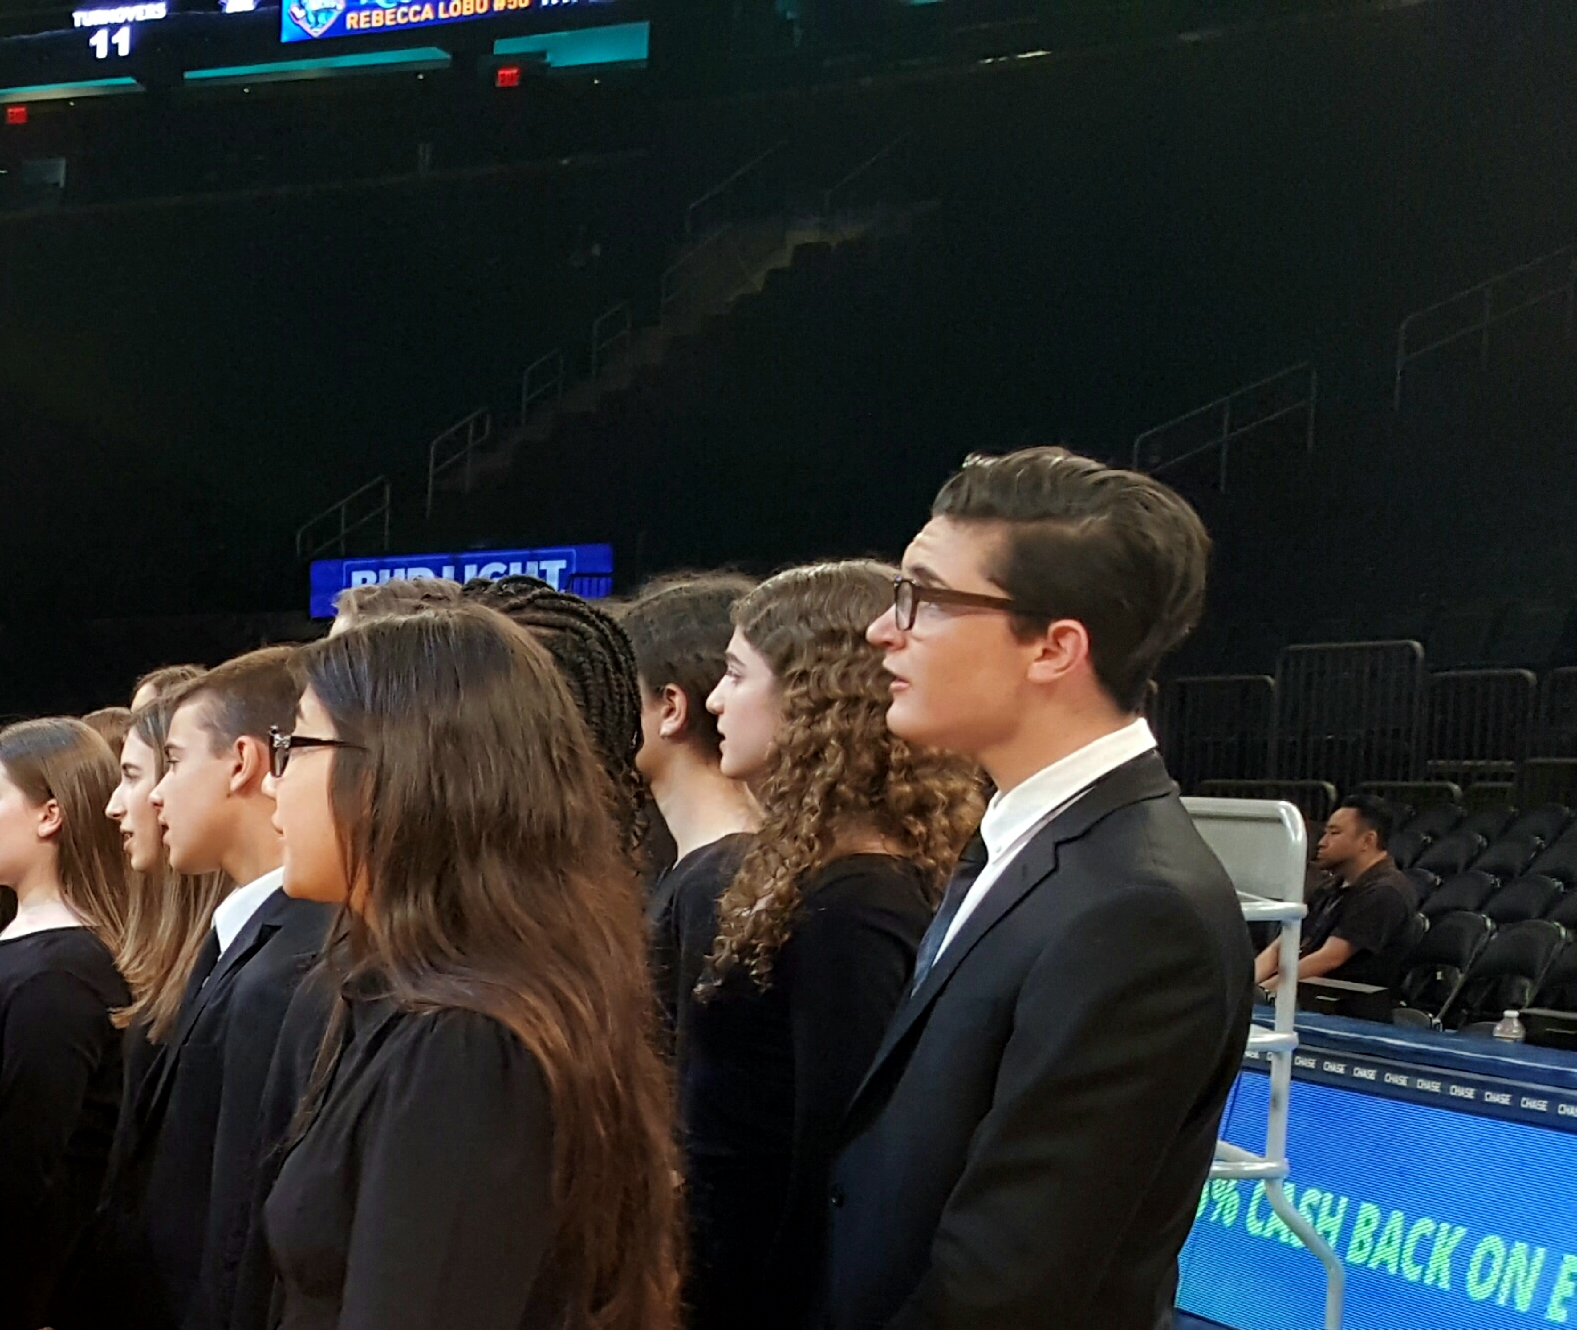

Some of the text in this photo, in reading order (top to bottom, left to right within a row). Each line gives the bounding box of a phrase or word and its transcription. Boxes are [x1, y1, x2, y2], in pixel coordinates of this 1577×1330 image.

[72, 2, 166, 27] TURNOVERS
[346, 3, 434, 30] REBECCA
[89, 26, 130, 58] 11
[1294, 1056, 1317, 1069] CHASE
[1323, 1061, 1346, 1075] CHASE
[1353, 1067, 1377, 1081] CHASE
[1384, 1072, 1408, 1087] CHASE
[1417, 1078, 1442, 1093] CHASE
[1450, 1084, 1476, 1099] CHASE
[1485, 1091, 1512, 1106] CHASE
[1520, 1097, 1548, 1112] CHASE
[1246, 1179, 1349, 1250] CASH
[1346, 1202, 1468, 1290] BACK
[1466, 1234, 1545, 1313] ON
[1546, 1254, 1577, 1324] E
